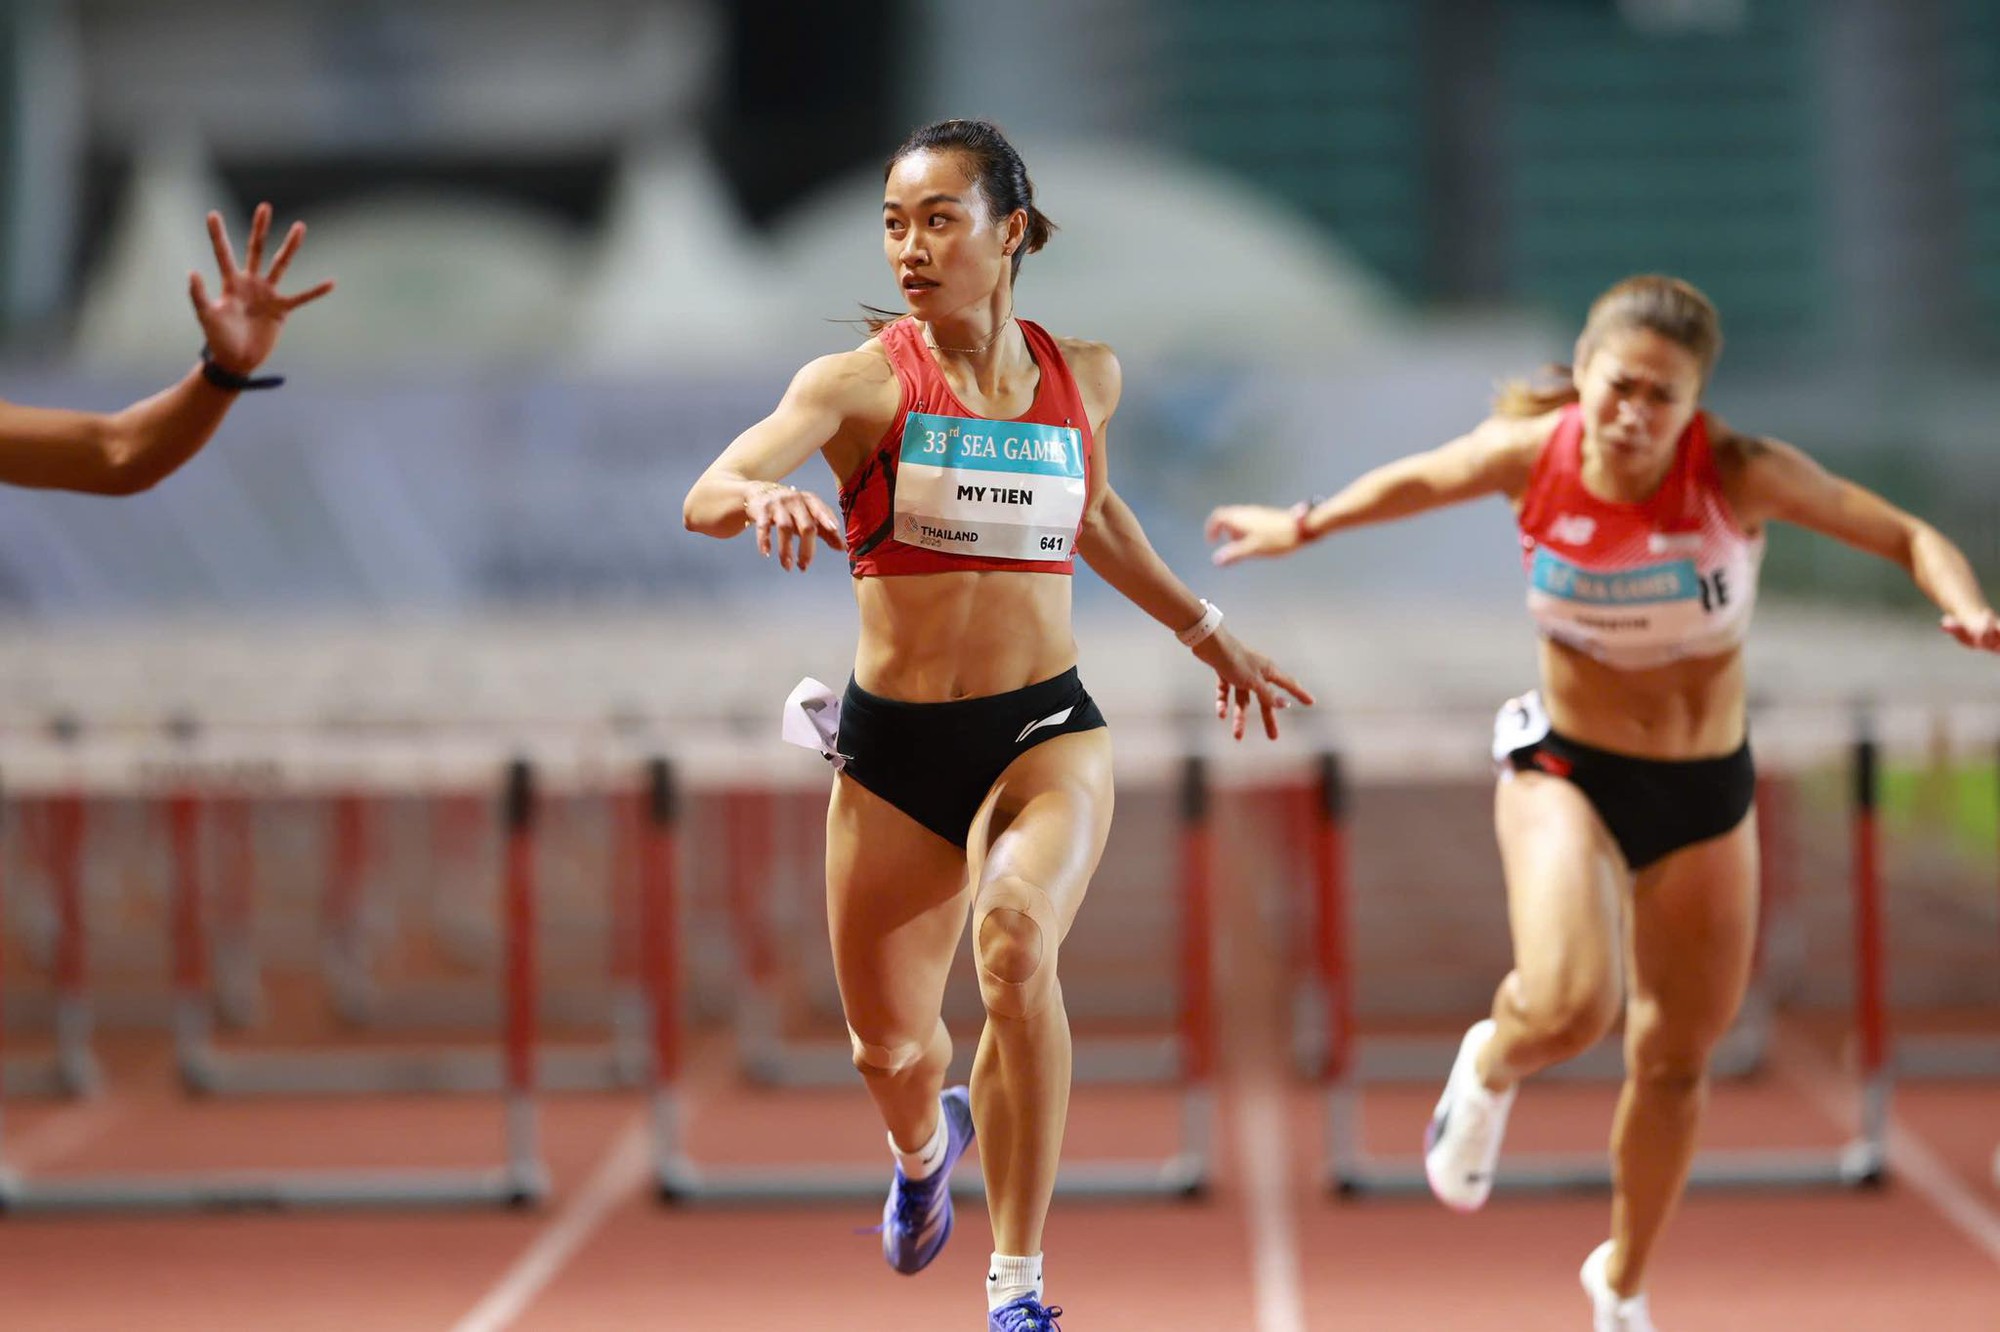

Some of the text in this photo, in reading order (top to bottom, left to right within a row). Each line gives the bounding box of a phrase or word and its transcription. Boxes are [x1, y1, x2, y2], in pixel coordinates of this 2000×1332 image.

[923, 426, 1067, 464] 33rd SEA GAMES
[957, 485, 1033, 506] MY TIEN
[919, 536, 942, 548] 2025
[921, 525, 979, 543] THAILAND
[1039, 536, 1064, 551] 641
